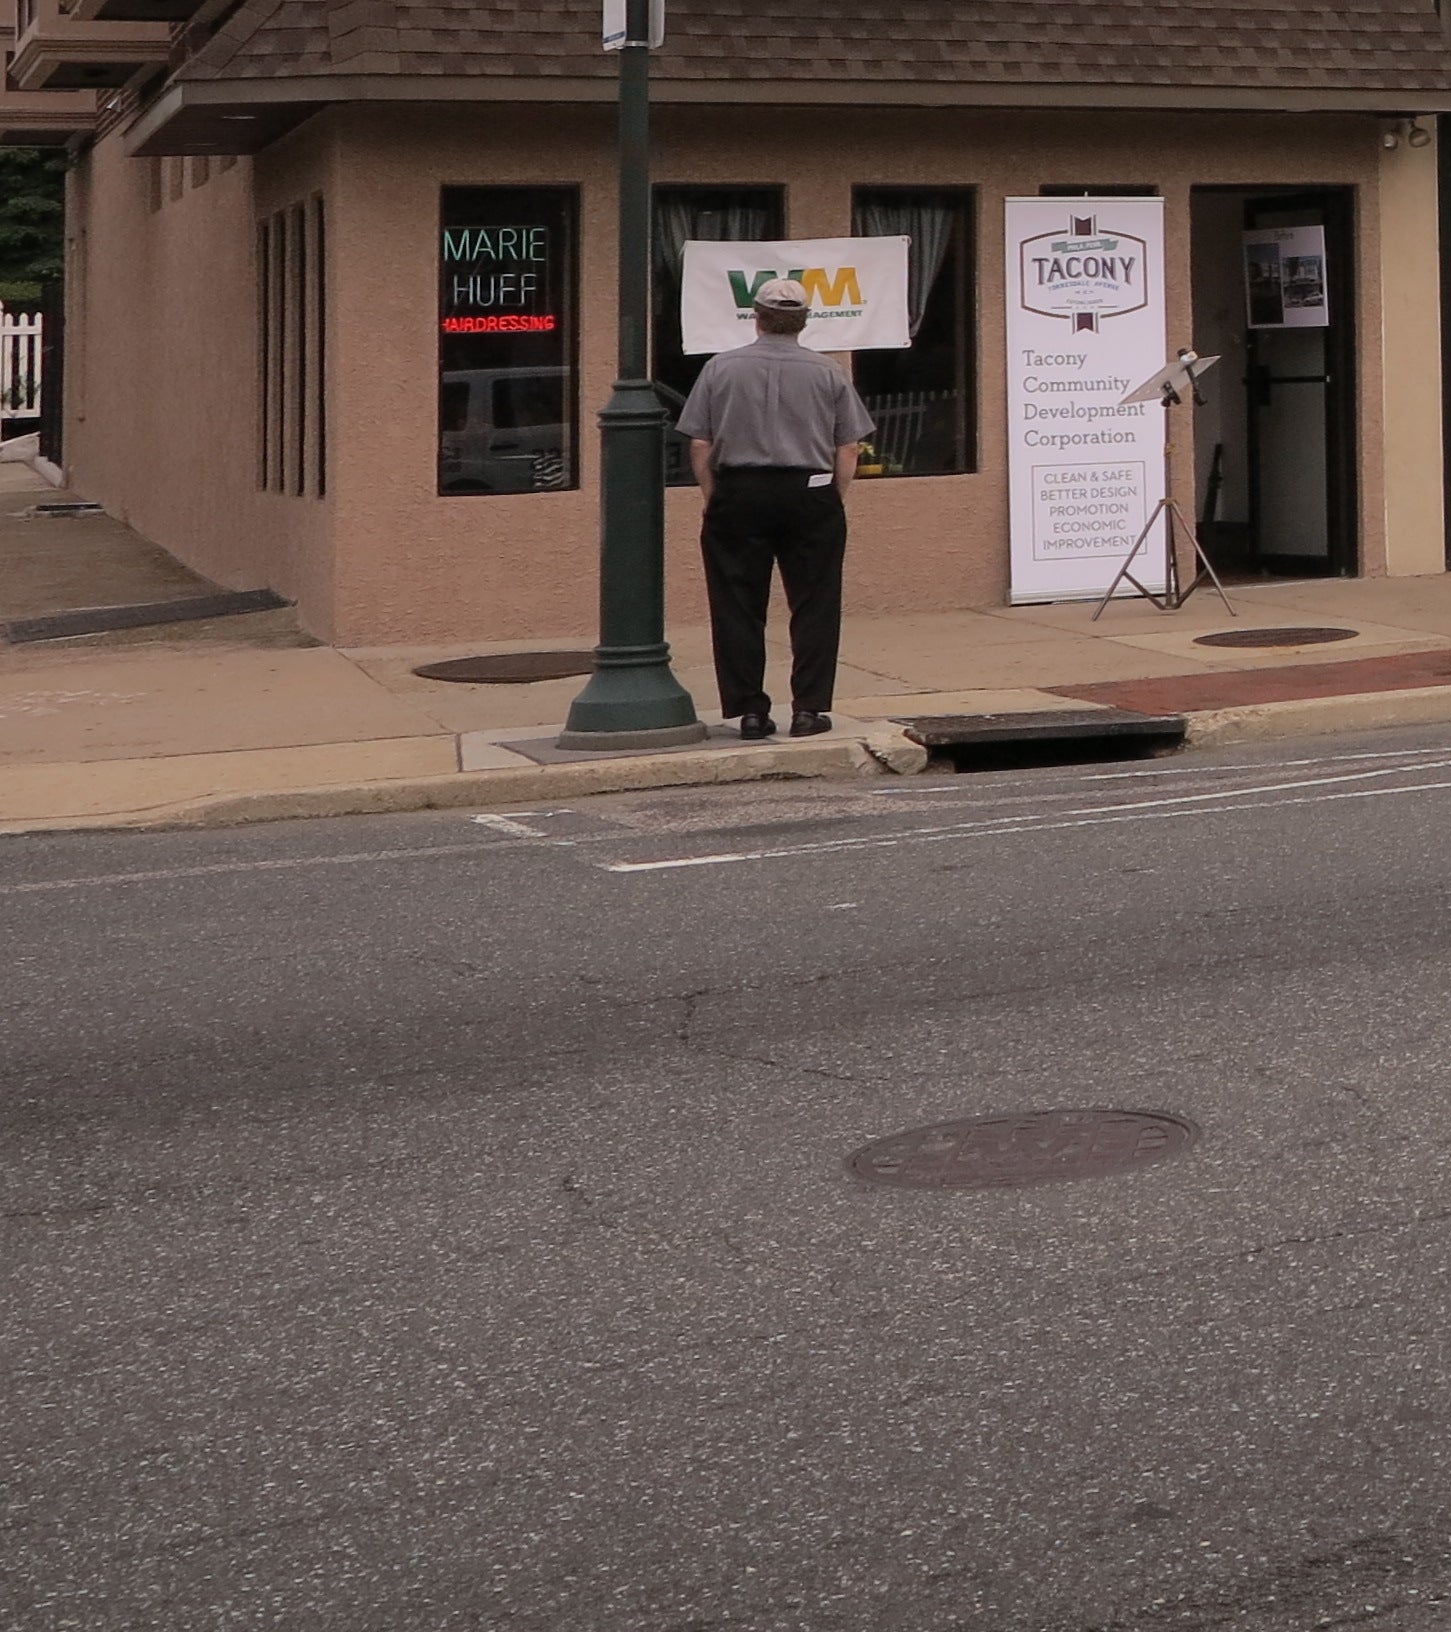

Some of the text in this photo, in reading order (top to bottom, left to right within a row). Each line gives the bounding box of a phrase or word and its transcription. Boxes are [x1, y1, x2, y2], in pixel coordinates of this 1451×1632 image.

[444, 229, 545, 261] MARIE
[1031, 256, 1136, 286] TACONY
[453, 274, 537, 306] HUFF
[1022, 349, 1087, 369] Tacony
[1023, 375, 1131, 394] Community
[1023, 401, 1146, 422] Development
[1024, 428, 1136, 450] Corporation
[1044, 469, 1133, 484] CLEAN & SAFE
[1040, 486, 1137, 501] BETTER DESIGN
[1049, 503, 1129, 516] PROMOTION
[1053, 519, 1126, 534] ECONOMIC
[1043, 535, 1136, 550] IMPROVEMENT
